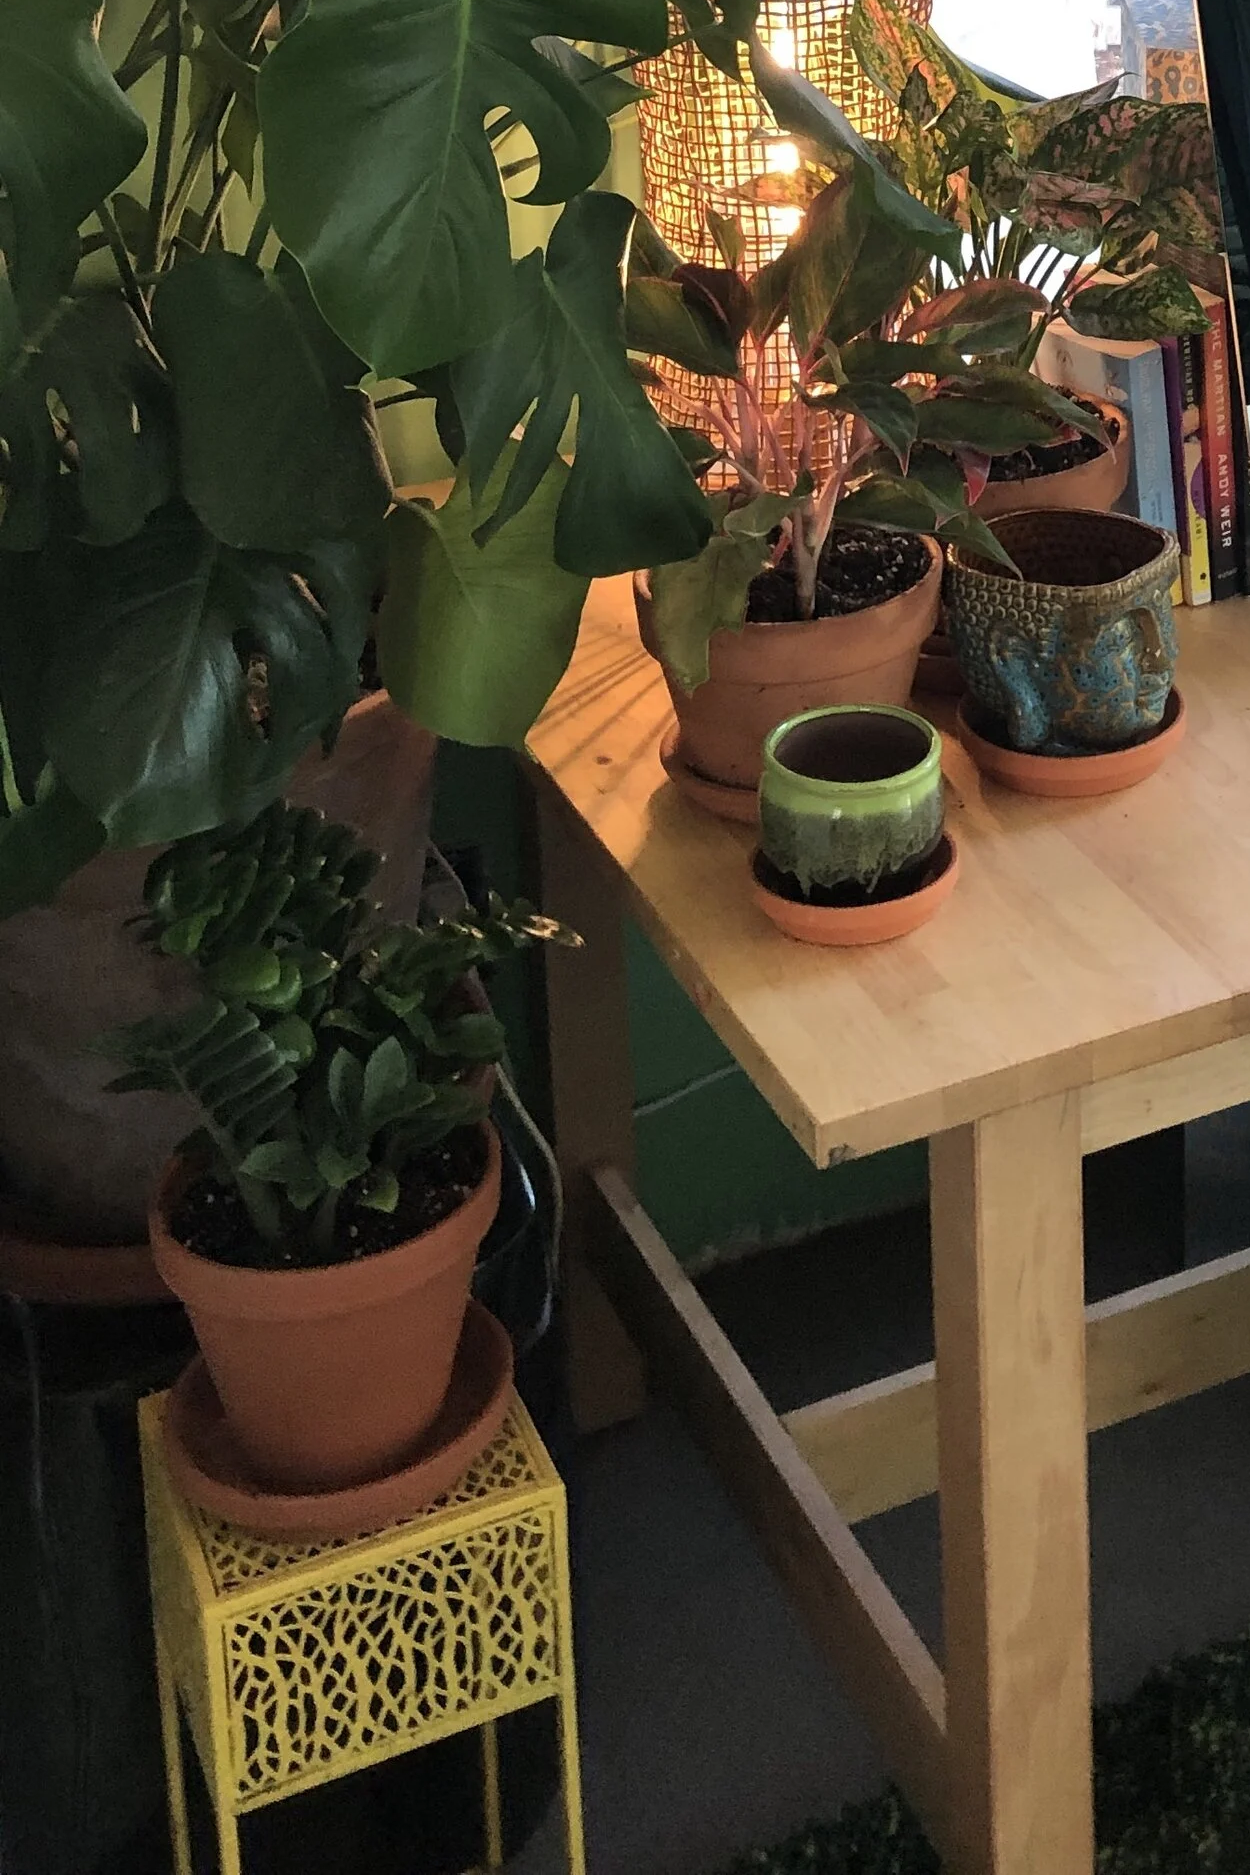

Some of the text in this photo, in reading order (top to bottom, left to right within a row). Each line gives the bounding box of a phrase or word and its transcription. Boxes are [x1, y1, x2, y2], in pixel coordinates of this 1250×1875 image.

[1211, 318, 1232, 548] THE MARTIAN ANDY WEIR
